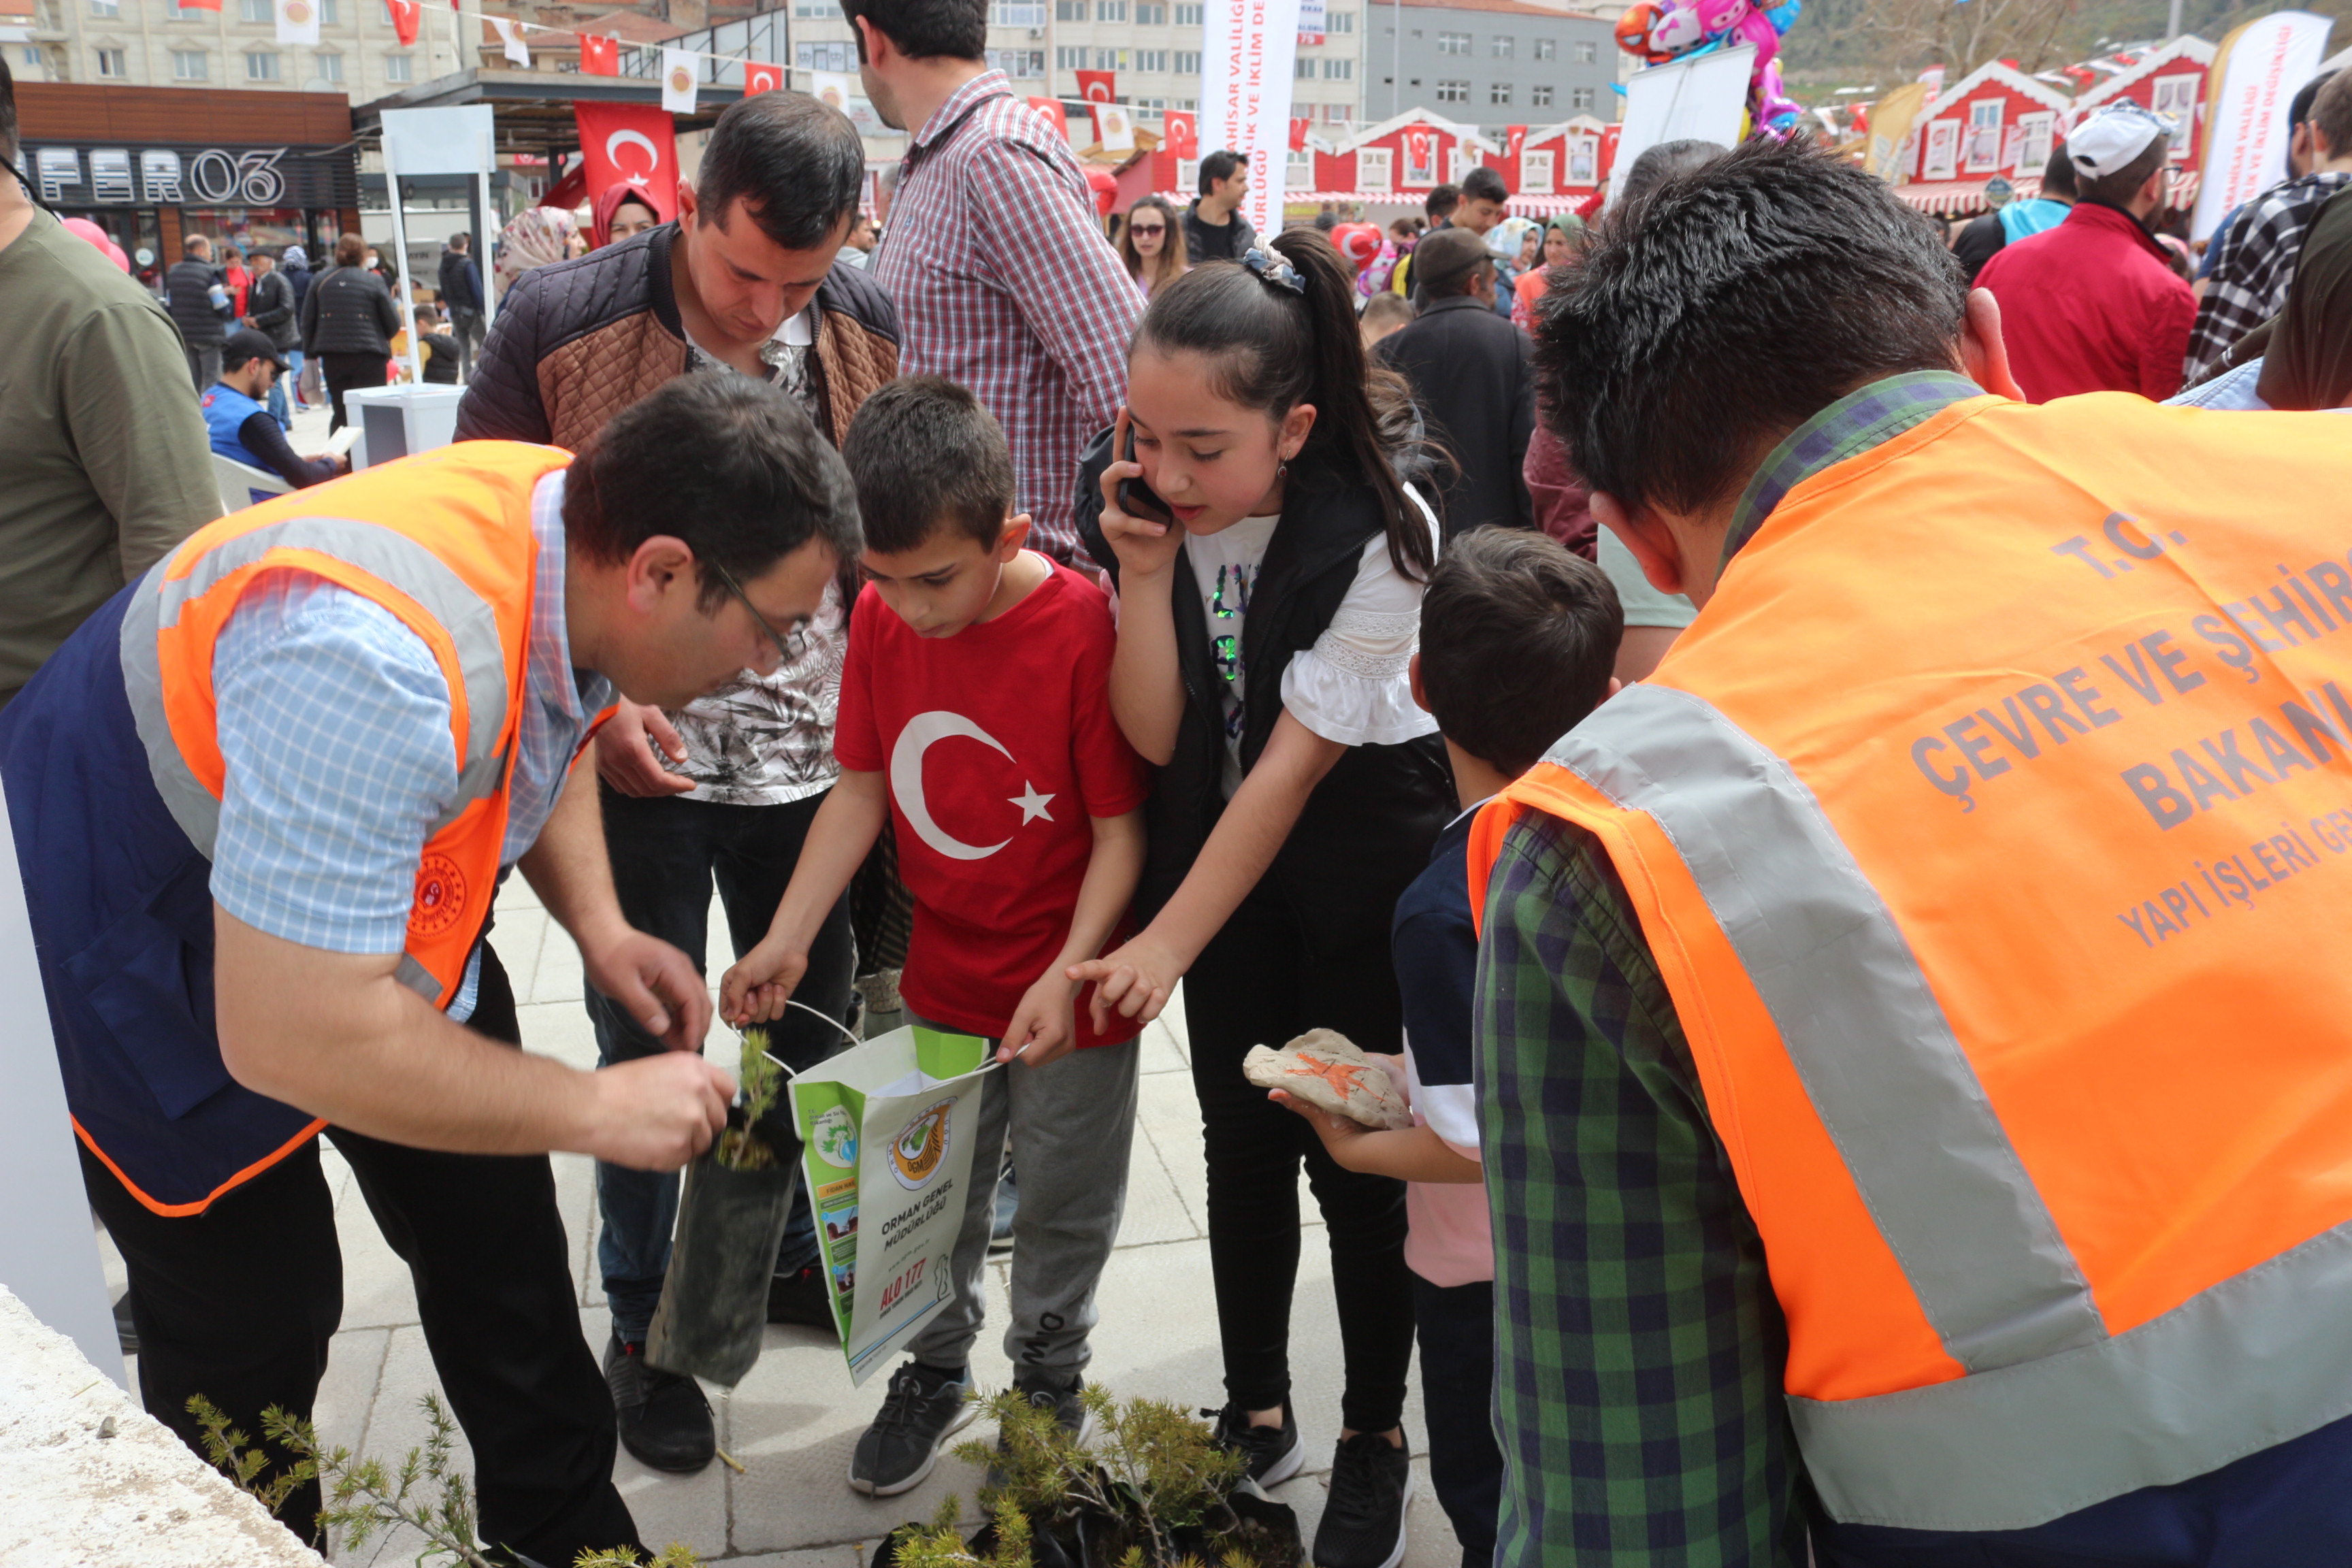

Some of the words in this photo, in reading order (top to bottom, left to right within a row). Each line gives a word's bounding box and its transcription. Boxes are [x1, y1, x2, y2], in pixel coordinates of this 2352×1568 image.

[1253, 0, 1265, 25] DE
[1245, 33, 1263, 86] İKLİM
[1224, 82, 1240, 152] AHİSAR
[1247, 93, 1260, 116] VE
[1911, 666, 2123, 814] ÇEVRE
[2099, 629, 2208, 706] VE
[2191, 546, 2352, 684] ŞEHİR
[2115, 880, 2211, 948] YAPI
[2193, 821, 2322, 911] İŞLERİ
[881, 1200, 921, 1235] ORMAN
[923, 1178, 953, 1208] GENEL
[884, 1196, 947, 1252] MÜDÜRLÜĞÜ
[880, 1275, 902, 1311] ALO
[905, 1257, 927, 1289] 177
